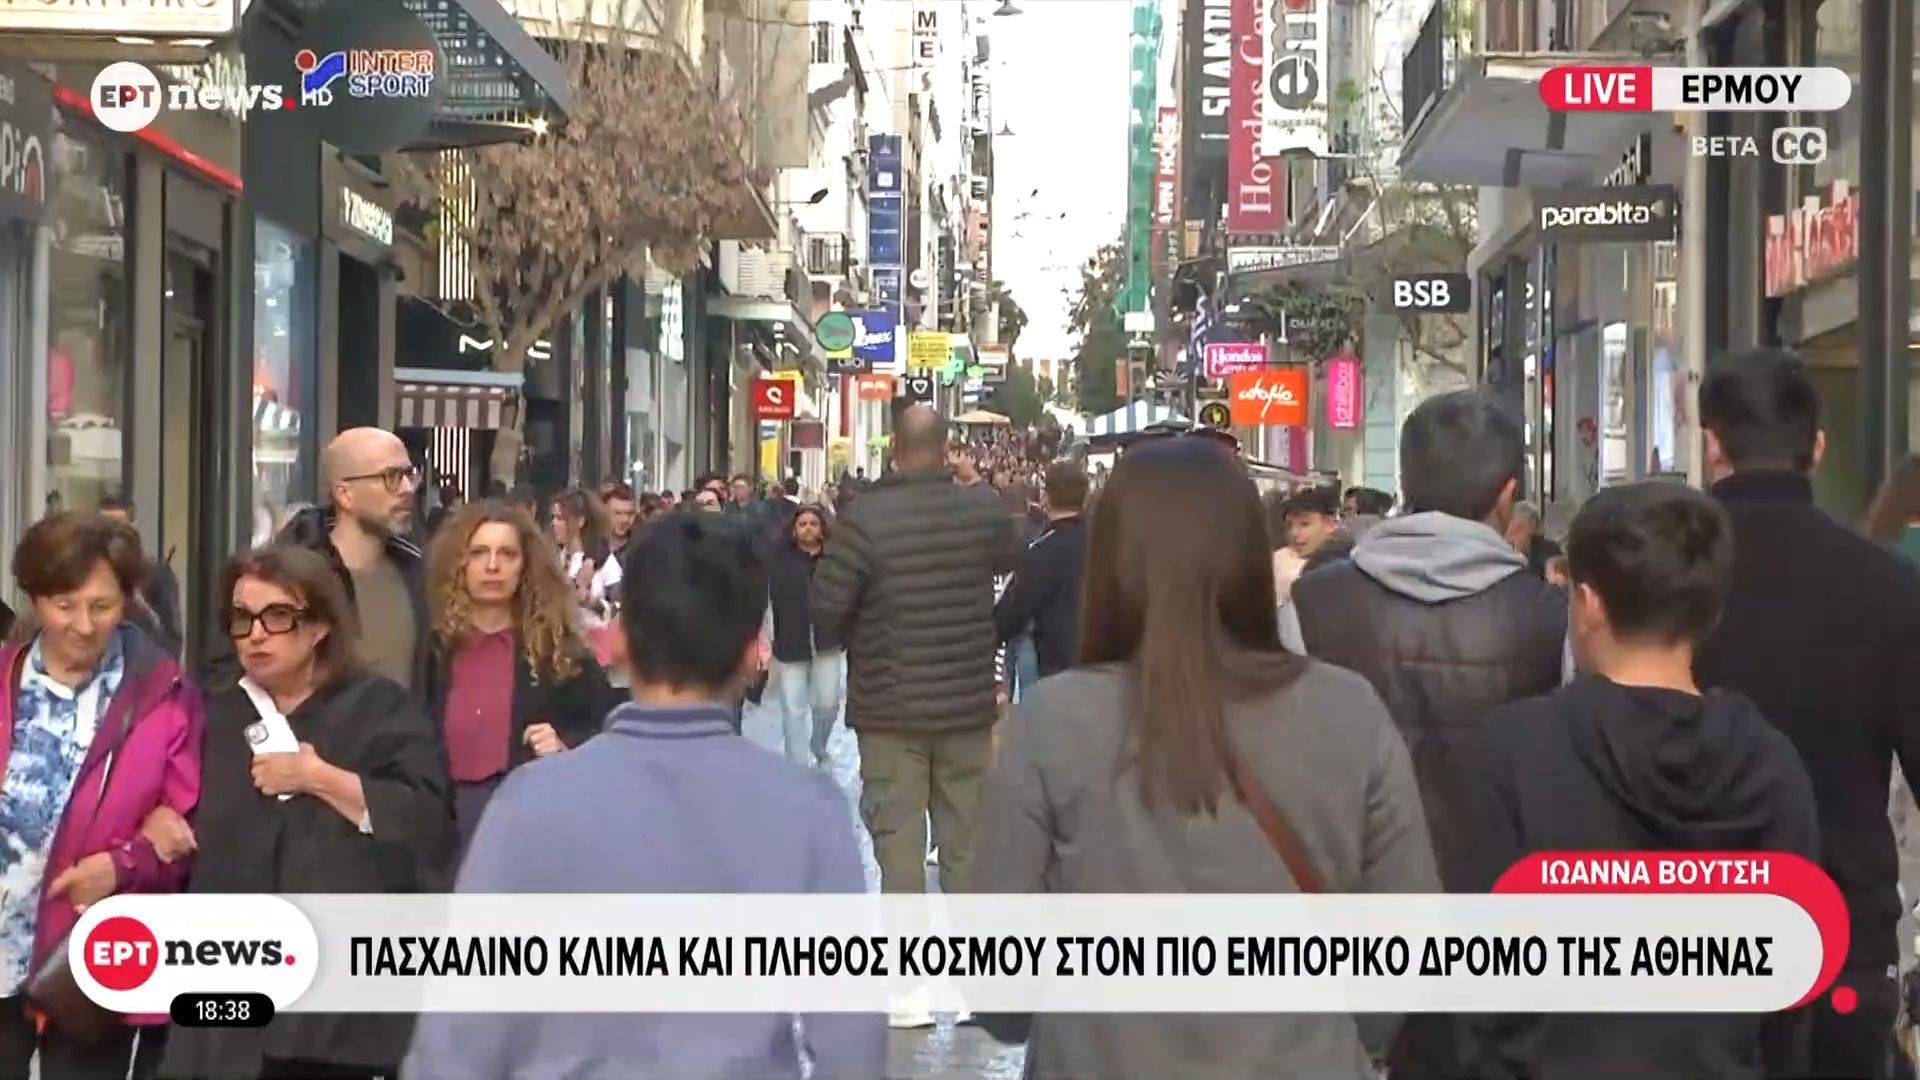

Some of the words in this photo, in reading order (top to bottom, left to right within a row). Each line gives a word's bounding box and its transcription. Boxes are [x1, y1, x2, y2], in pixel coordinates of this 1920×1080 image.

[350, 49, 434, 75] INTER
[350, 74, 433, 98] SPORT
[1394, 280, 1451, 307] BSB
